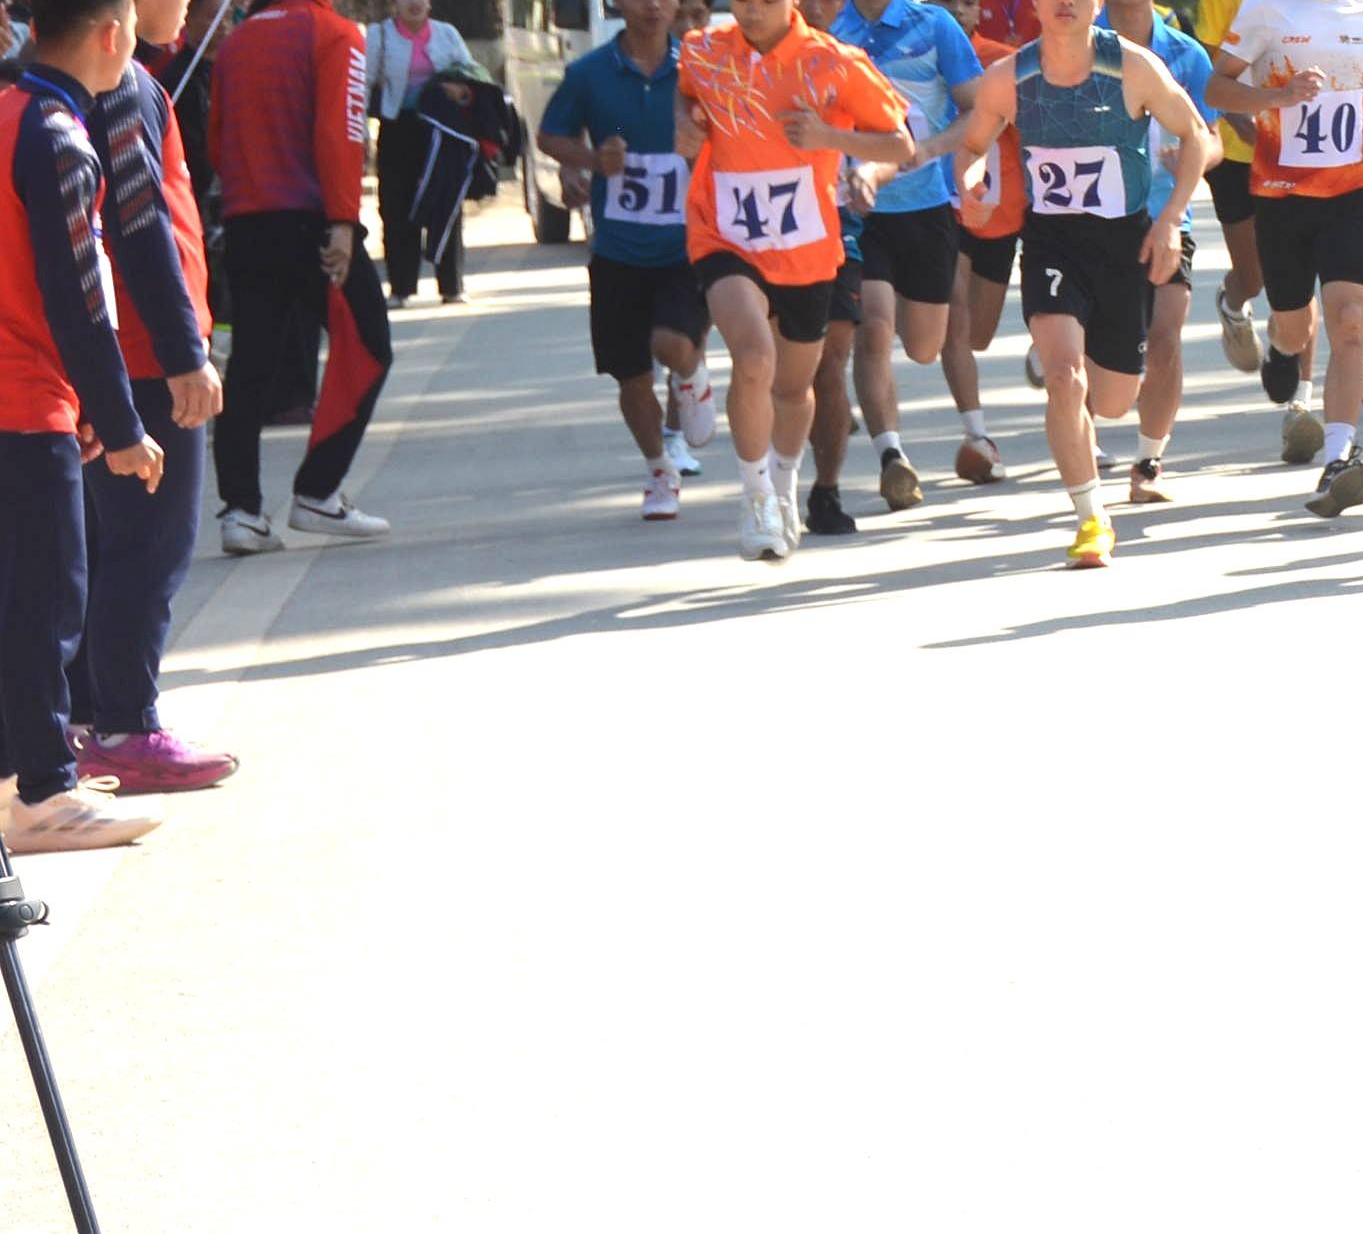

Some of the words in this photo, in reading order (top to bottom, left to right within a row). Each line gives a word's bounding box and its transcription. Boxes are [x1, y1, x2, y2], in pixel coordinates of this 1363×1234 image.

[1294, 102, 1357, 154] 40
[618, 167, 681, 215] 51
[1038, 156, 1105, 208] 27
[731, 178, 799, 241] 47
[1045, 267, 1063, 298] 7
